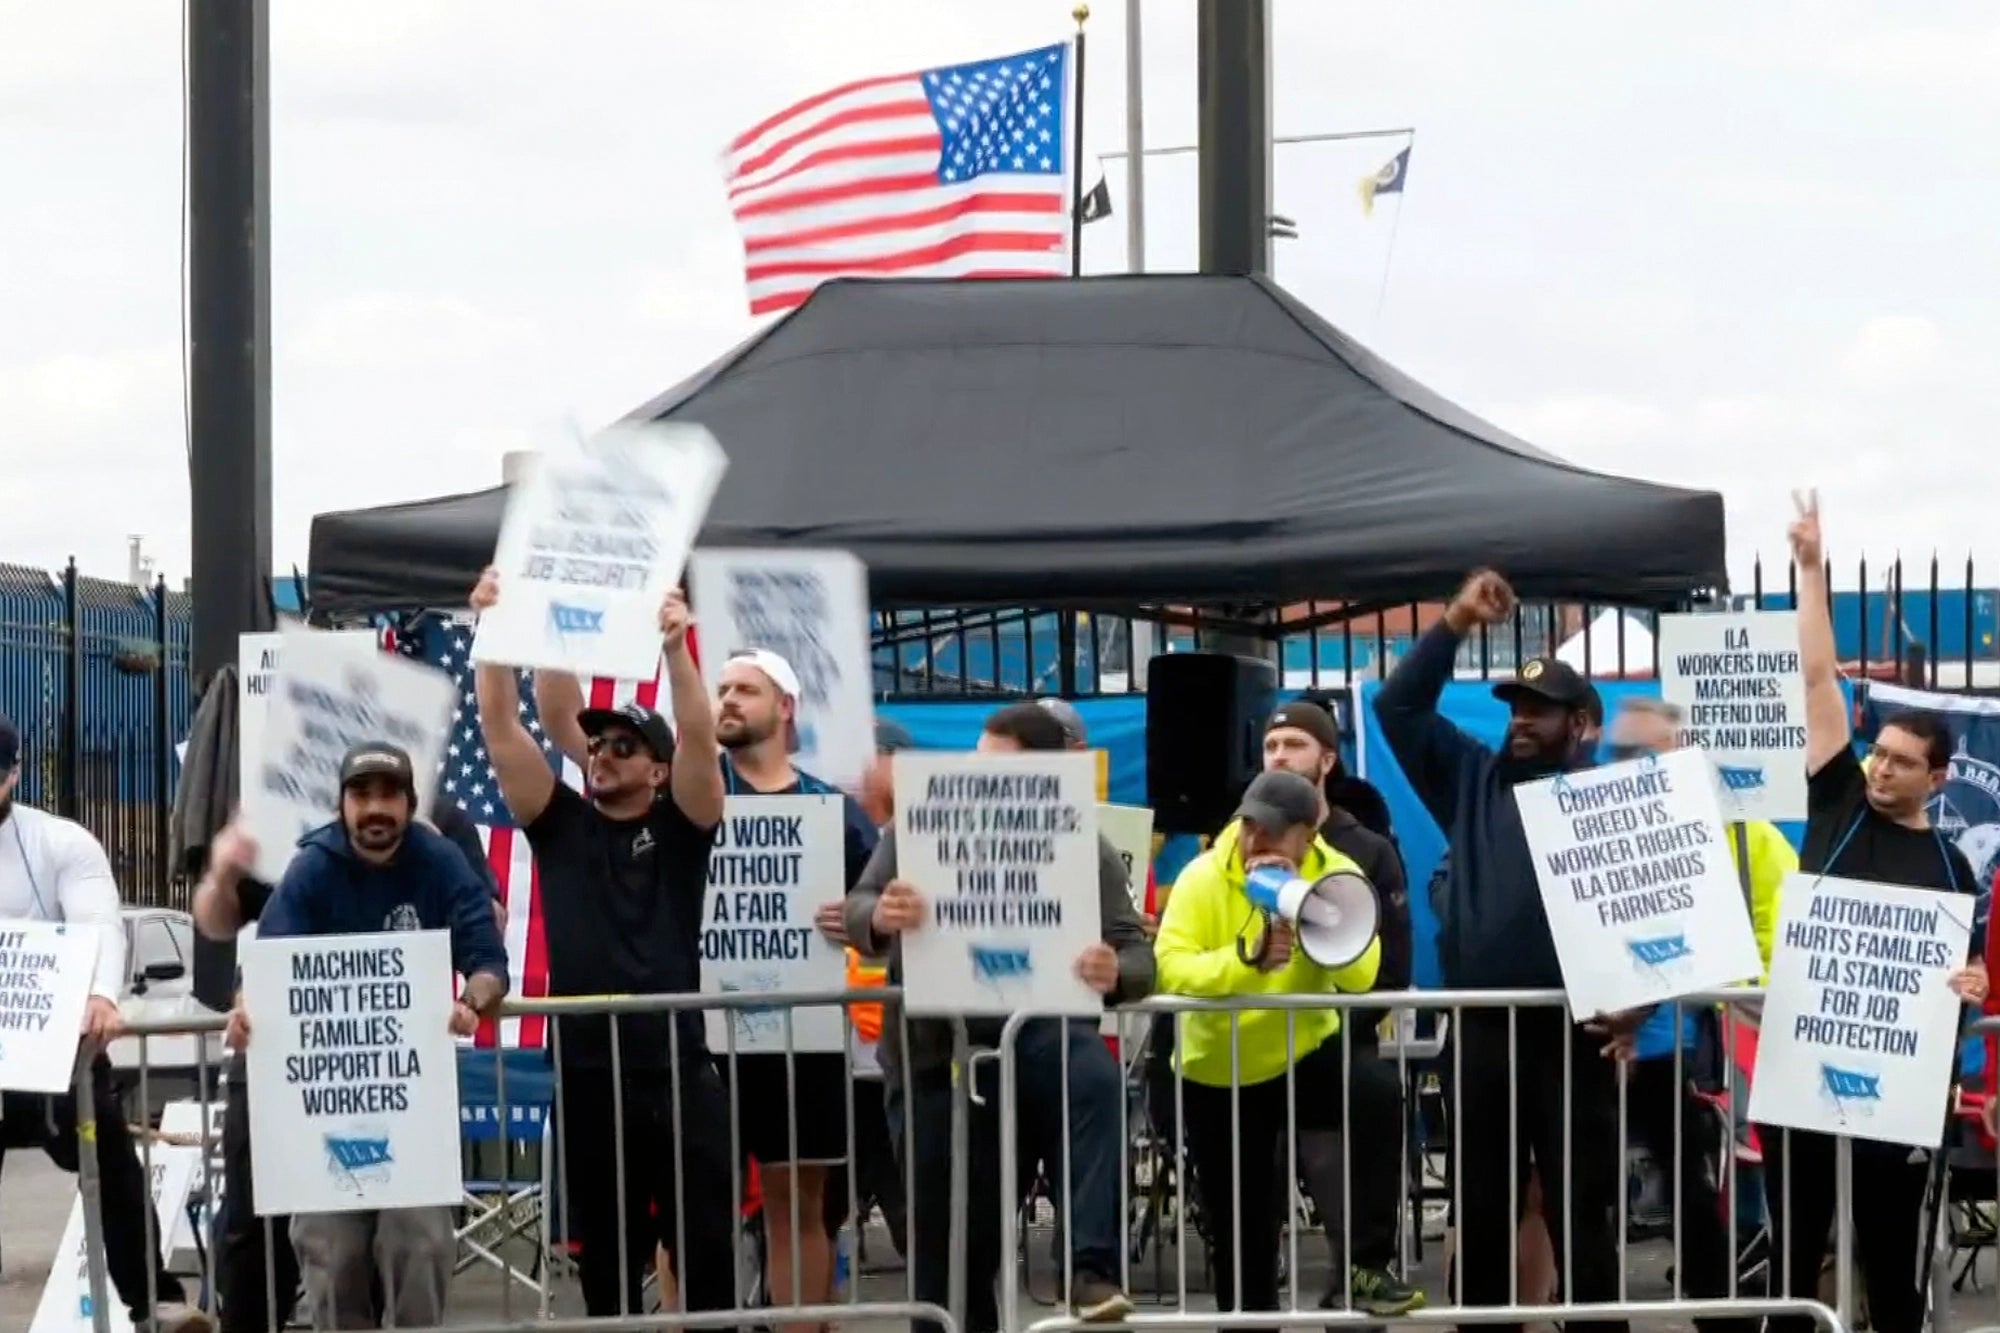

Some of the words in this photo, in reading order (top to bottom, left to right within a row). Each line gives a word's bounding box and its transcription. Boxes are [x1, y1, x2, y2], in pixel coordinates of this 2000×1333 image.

[1724, 627, 1749, 650] ILA
[1677, 653, 1754, 676] WORKERS
[1757, 650, 1798, 674] OVER
[1695, 678, 1782, 701] MACHINES:
[1691, 703, 1752, 726] DEFEND
[1755, 702, 1787, 724] OUR
[1715, 728, 1748, 750] AND
[1750, 726, 1807, 750] RIGHTS
[927, 774, 1061, 801] AUTOMATION
[1557, 769, 1673, 816] CORPORATE
[712, 817, 726, 848] O
[733, 815, 804, 848] WORK
[908, 804, 976, 835] HURTS
[981, 804, 1082, 836] FAMILIES:
[1572, 806, 1638, 842] GREED
[1641, 800, 1674, 825] VS.
[937, 835, 971, 866] ILA
[974, 835, 1055, 865] STANDS
[1546, 839, 1634, 878] WORKER
[1636, 821, 1714, 858] RIGHTS:
[957, 869, 996, 895] FOR
[1003, 868, 1038, 895] JOB
[1571, 872, 1605, 903] ILA
[1606, 850, 1706, 894] DEMANDS
[713, 892, 730, 923] A
[735, 891, 788, 923] FAIR
[936, 898, 1063, 928] PROTECTION
[1597, 884, 1695, 928] FAIRNESS
[1808, 895, 1938, 935] AUTOMATION
[699, 928, 813, 961] ONTRACT
[1786, 922, 1852, 955] HURTS
[1855, 930, 1953, 970] FAMILIES:
[291, 947, 405, 981] MACHINES
[1807, 955, 1839, 984] ILA
[1843, 960, 1922, 995] STANDS
[288, 985, 352, 1016] DON'T
[357, 982, 411, 1013] FEED
[1820, 987, 1861, 1018] FOR
[1863, 994, 1901, 1024] JOB
[300, 1015, 404, 1049] FAMILIES:
[1794, 1015, 1919, 1057] PROTECTION
[286, 1051, 382, 1084] SUPPORT
[387, 1049, 422, 1079] ILA
[302, 1083, 409, 1116] WORKERS
